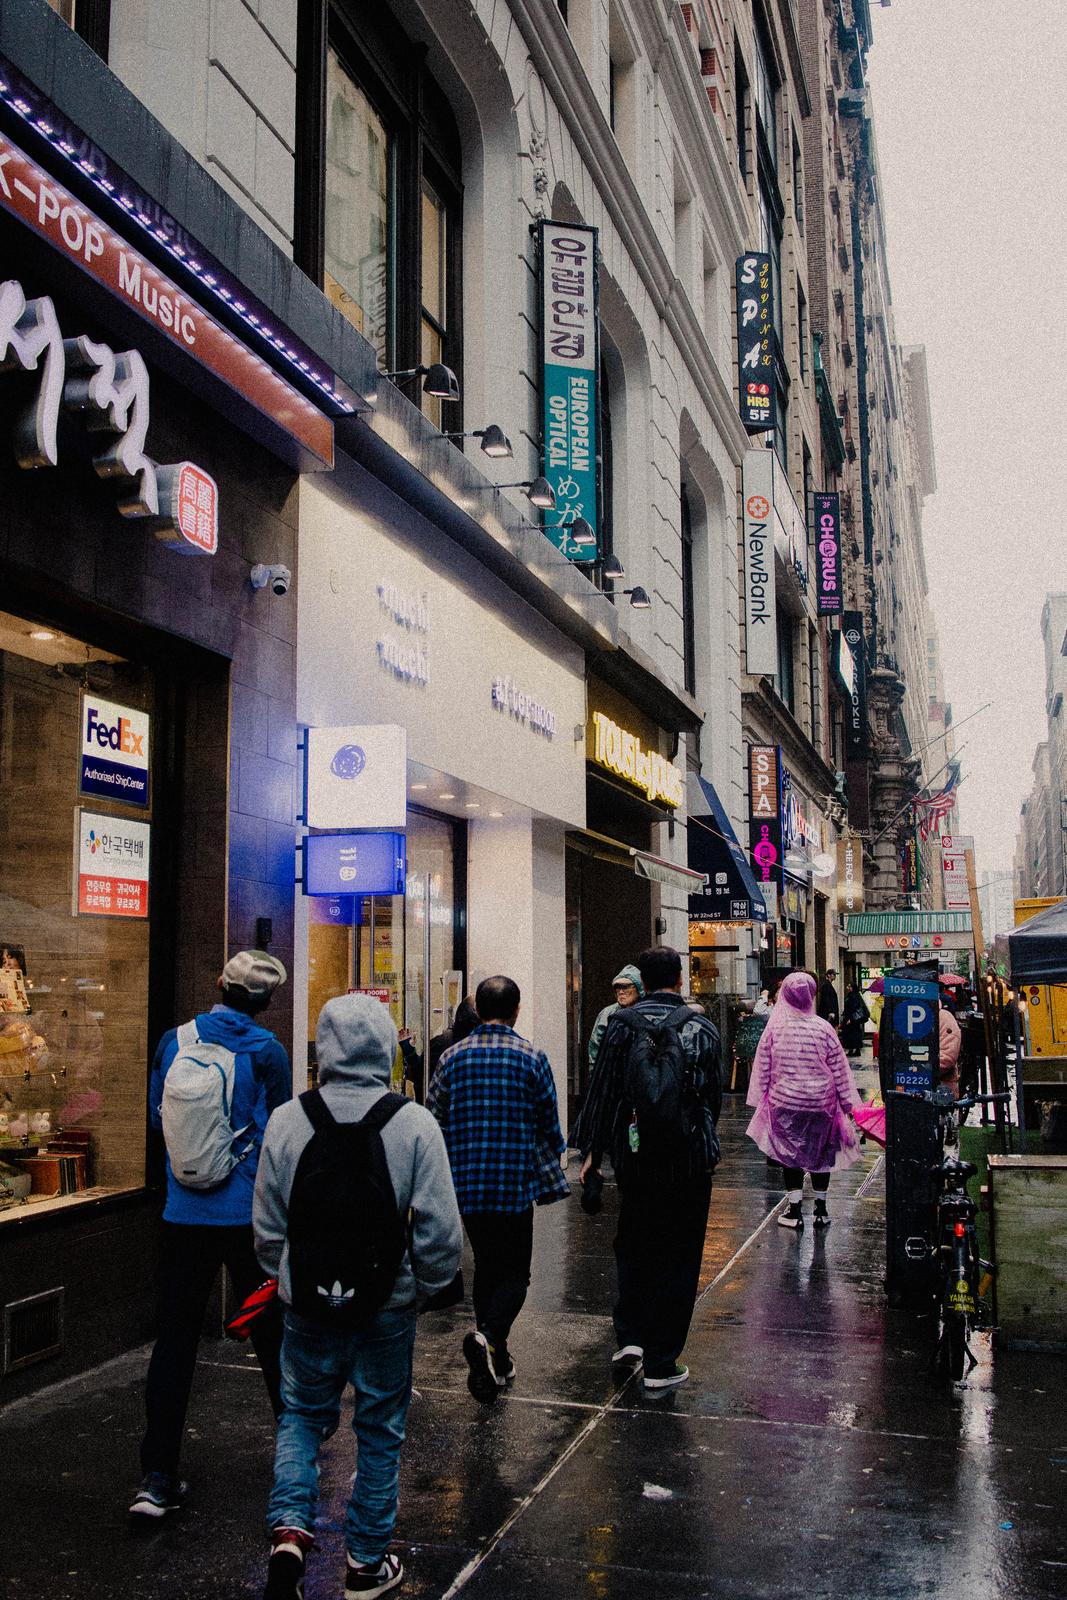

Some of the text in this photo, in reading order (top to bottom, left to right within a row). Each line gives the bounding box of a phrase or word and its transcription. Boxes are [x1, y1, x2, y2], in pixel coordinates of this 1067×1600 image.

[0, 152, 105, 263] K-POP
[118, 250, 197, 345] Music
[740, 257, 761, 369] SPA
[747, 396, 769, 407] HRS
[748, 383, 769, 395] 24
[549, 395, 568, 469] OPTICAL
[569, 376, 589, 471] EUROPEAN
[749, 409, 769, 421] 5F
[557, 474, 583, 554] めがね
[822, 501, 831, 509] 3F
[819, 513, 838, 592] CHORUS
[749, 522, 771, 625] NewBank
[850, 649, 861, 729] KARAOKE
[87, 708, 144, 757] FedEx
[84, 767, 145, 790] Authorized ShipCenter
[756, 754, 772, 812] SPA
[102, 833, 144, 859] 한국택배
[753, 824, 777, 881] CHORU
[715, 887, 731, 896] 정보
[885, 935, 943, 948] WONJO
[890, 984, 926, 994] 102226
[907, 1005, 927, 1034] P
[896, 1075, 930, 1085] 102226
